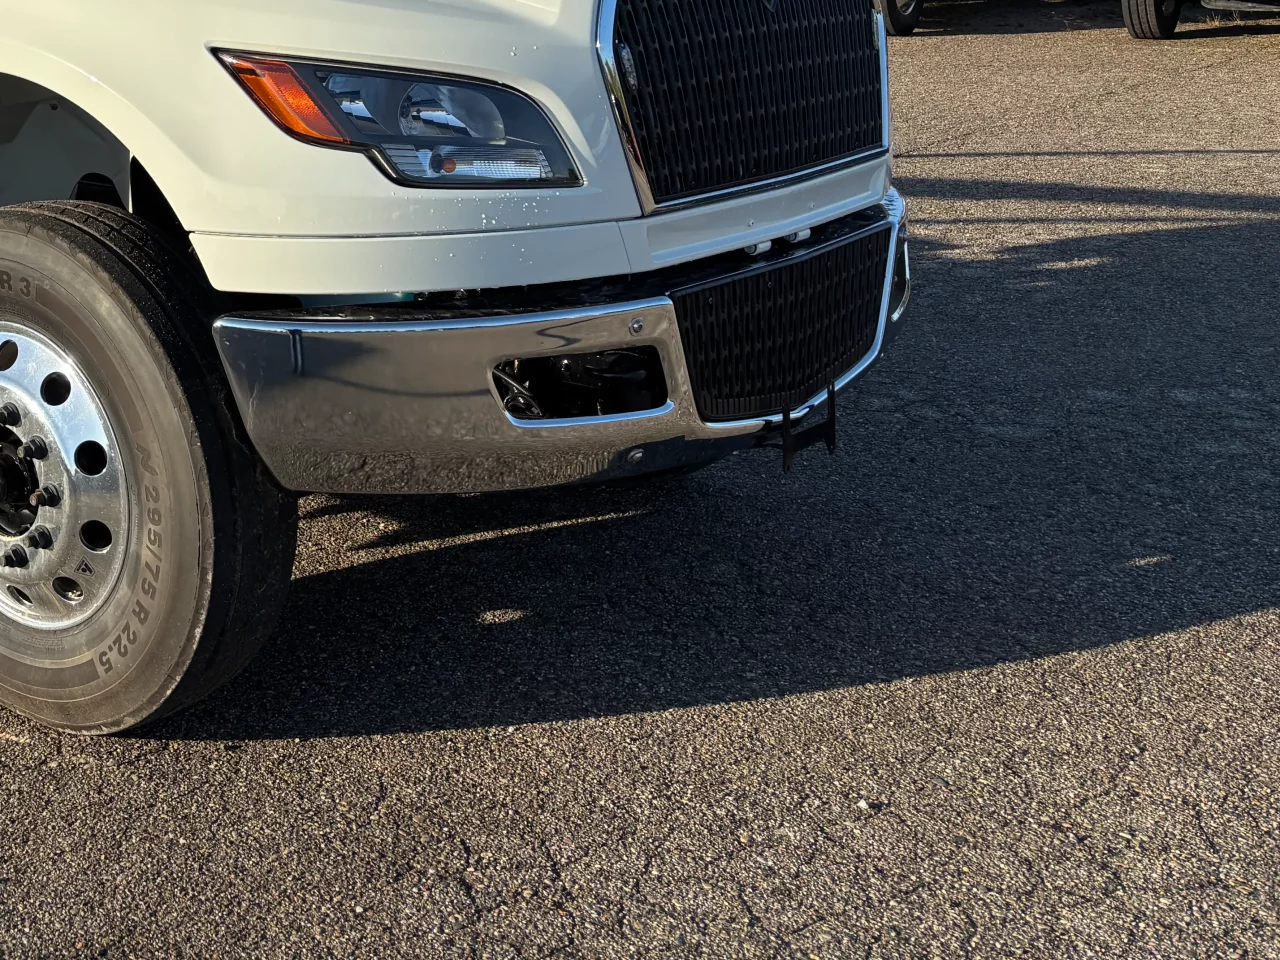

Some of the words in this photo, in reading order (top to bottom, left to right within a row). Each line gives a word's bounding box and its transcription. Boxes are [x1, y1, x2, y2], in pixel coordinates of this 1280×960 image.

[19, 276, 31, 298] 3
[140, 485, 163, 601] 295/75
[131, 599, 151, 626] R
[98, 620, 138, 675] 22.5
